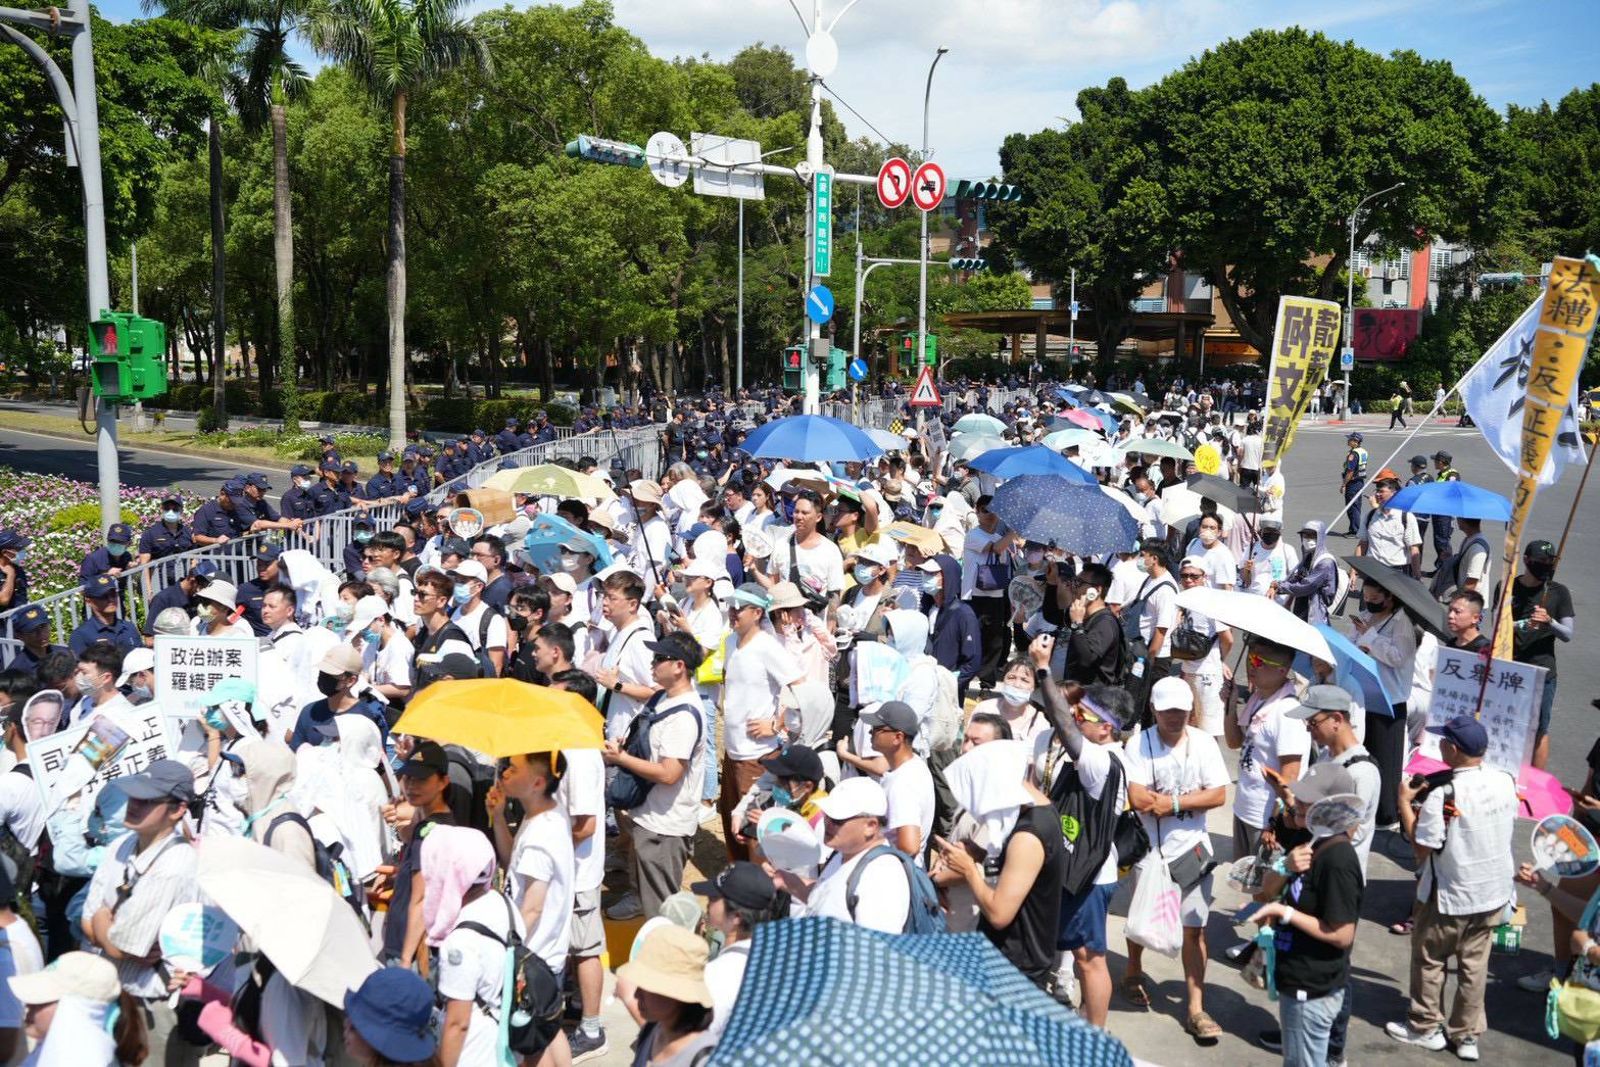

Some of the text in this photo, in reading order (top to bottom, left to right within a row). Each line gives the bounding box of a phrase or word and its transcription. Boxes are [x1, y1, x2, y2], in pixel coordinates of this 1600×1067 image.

[170, 647, 242, 668] 政治辦案
[171, 671, 241, 692] 羅織罪
